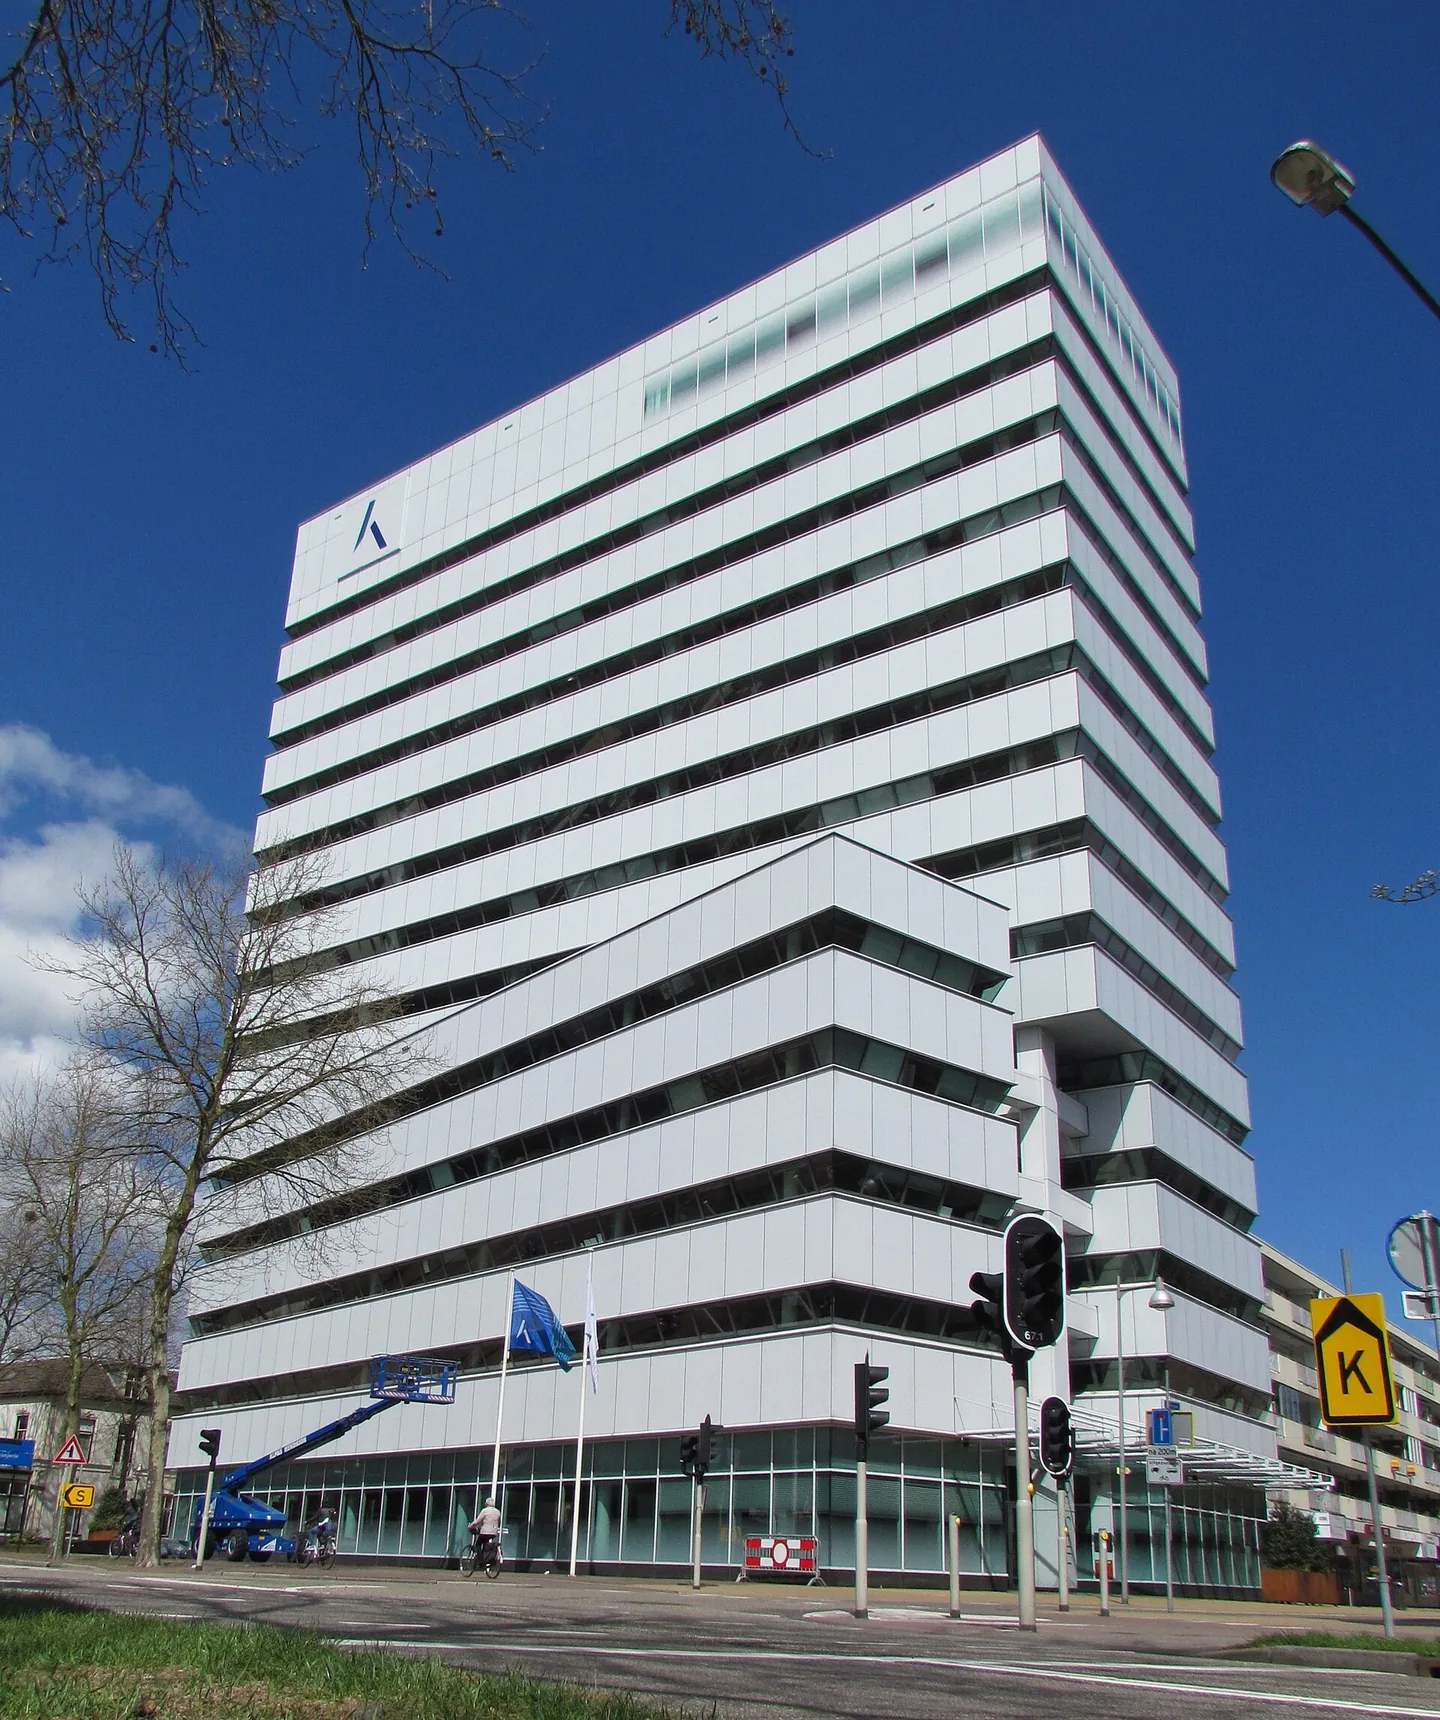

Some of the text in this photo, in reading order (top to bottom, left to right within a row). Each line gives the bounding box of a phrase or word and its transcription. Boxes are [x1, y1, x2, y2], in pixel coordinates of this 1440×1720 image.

[1024, 1330, 1043, 1341] 67.1
[1337, 1349, 1373, 1395] K
[76, 1490, 85, 1502] S
